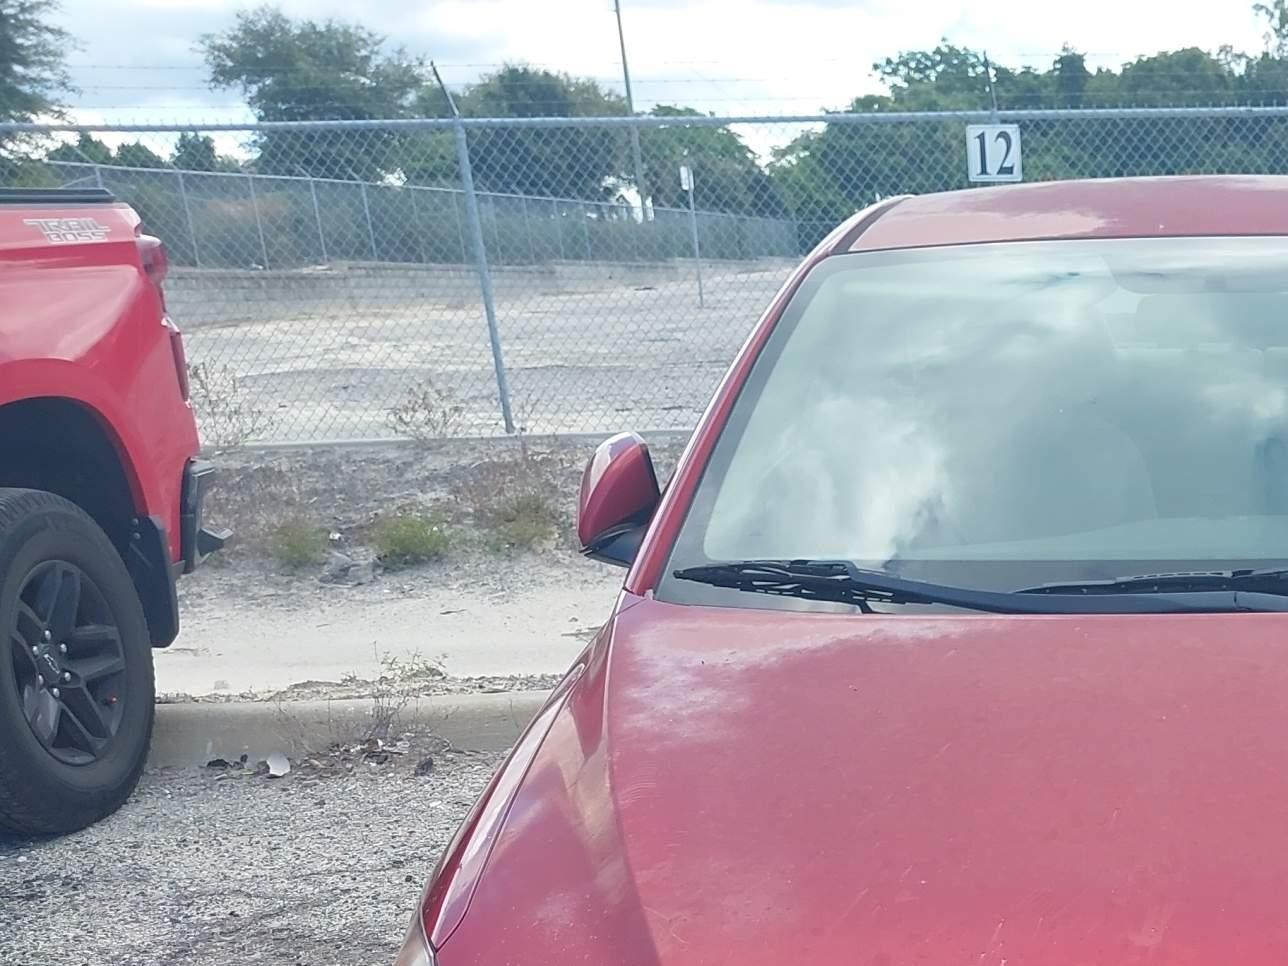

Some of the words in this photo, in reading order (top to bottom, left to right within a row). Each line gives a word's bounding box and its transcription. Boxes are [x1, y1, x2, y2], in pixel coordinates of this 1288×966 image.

[974, 130, 1015, 176] 12
[23, 218, 112, 232] TRAIL
[46, 231, 108, 243] BOSS
